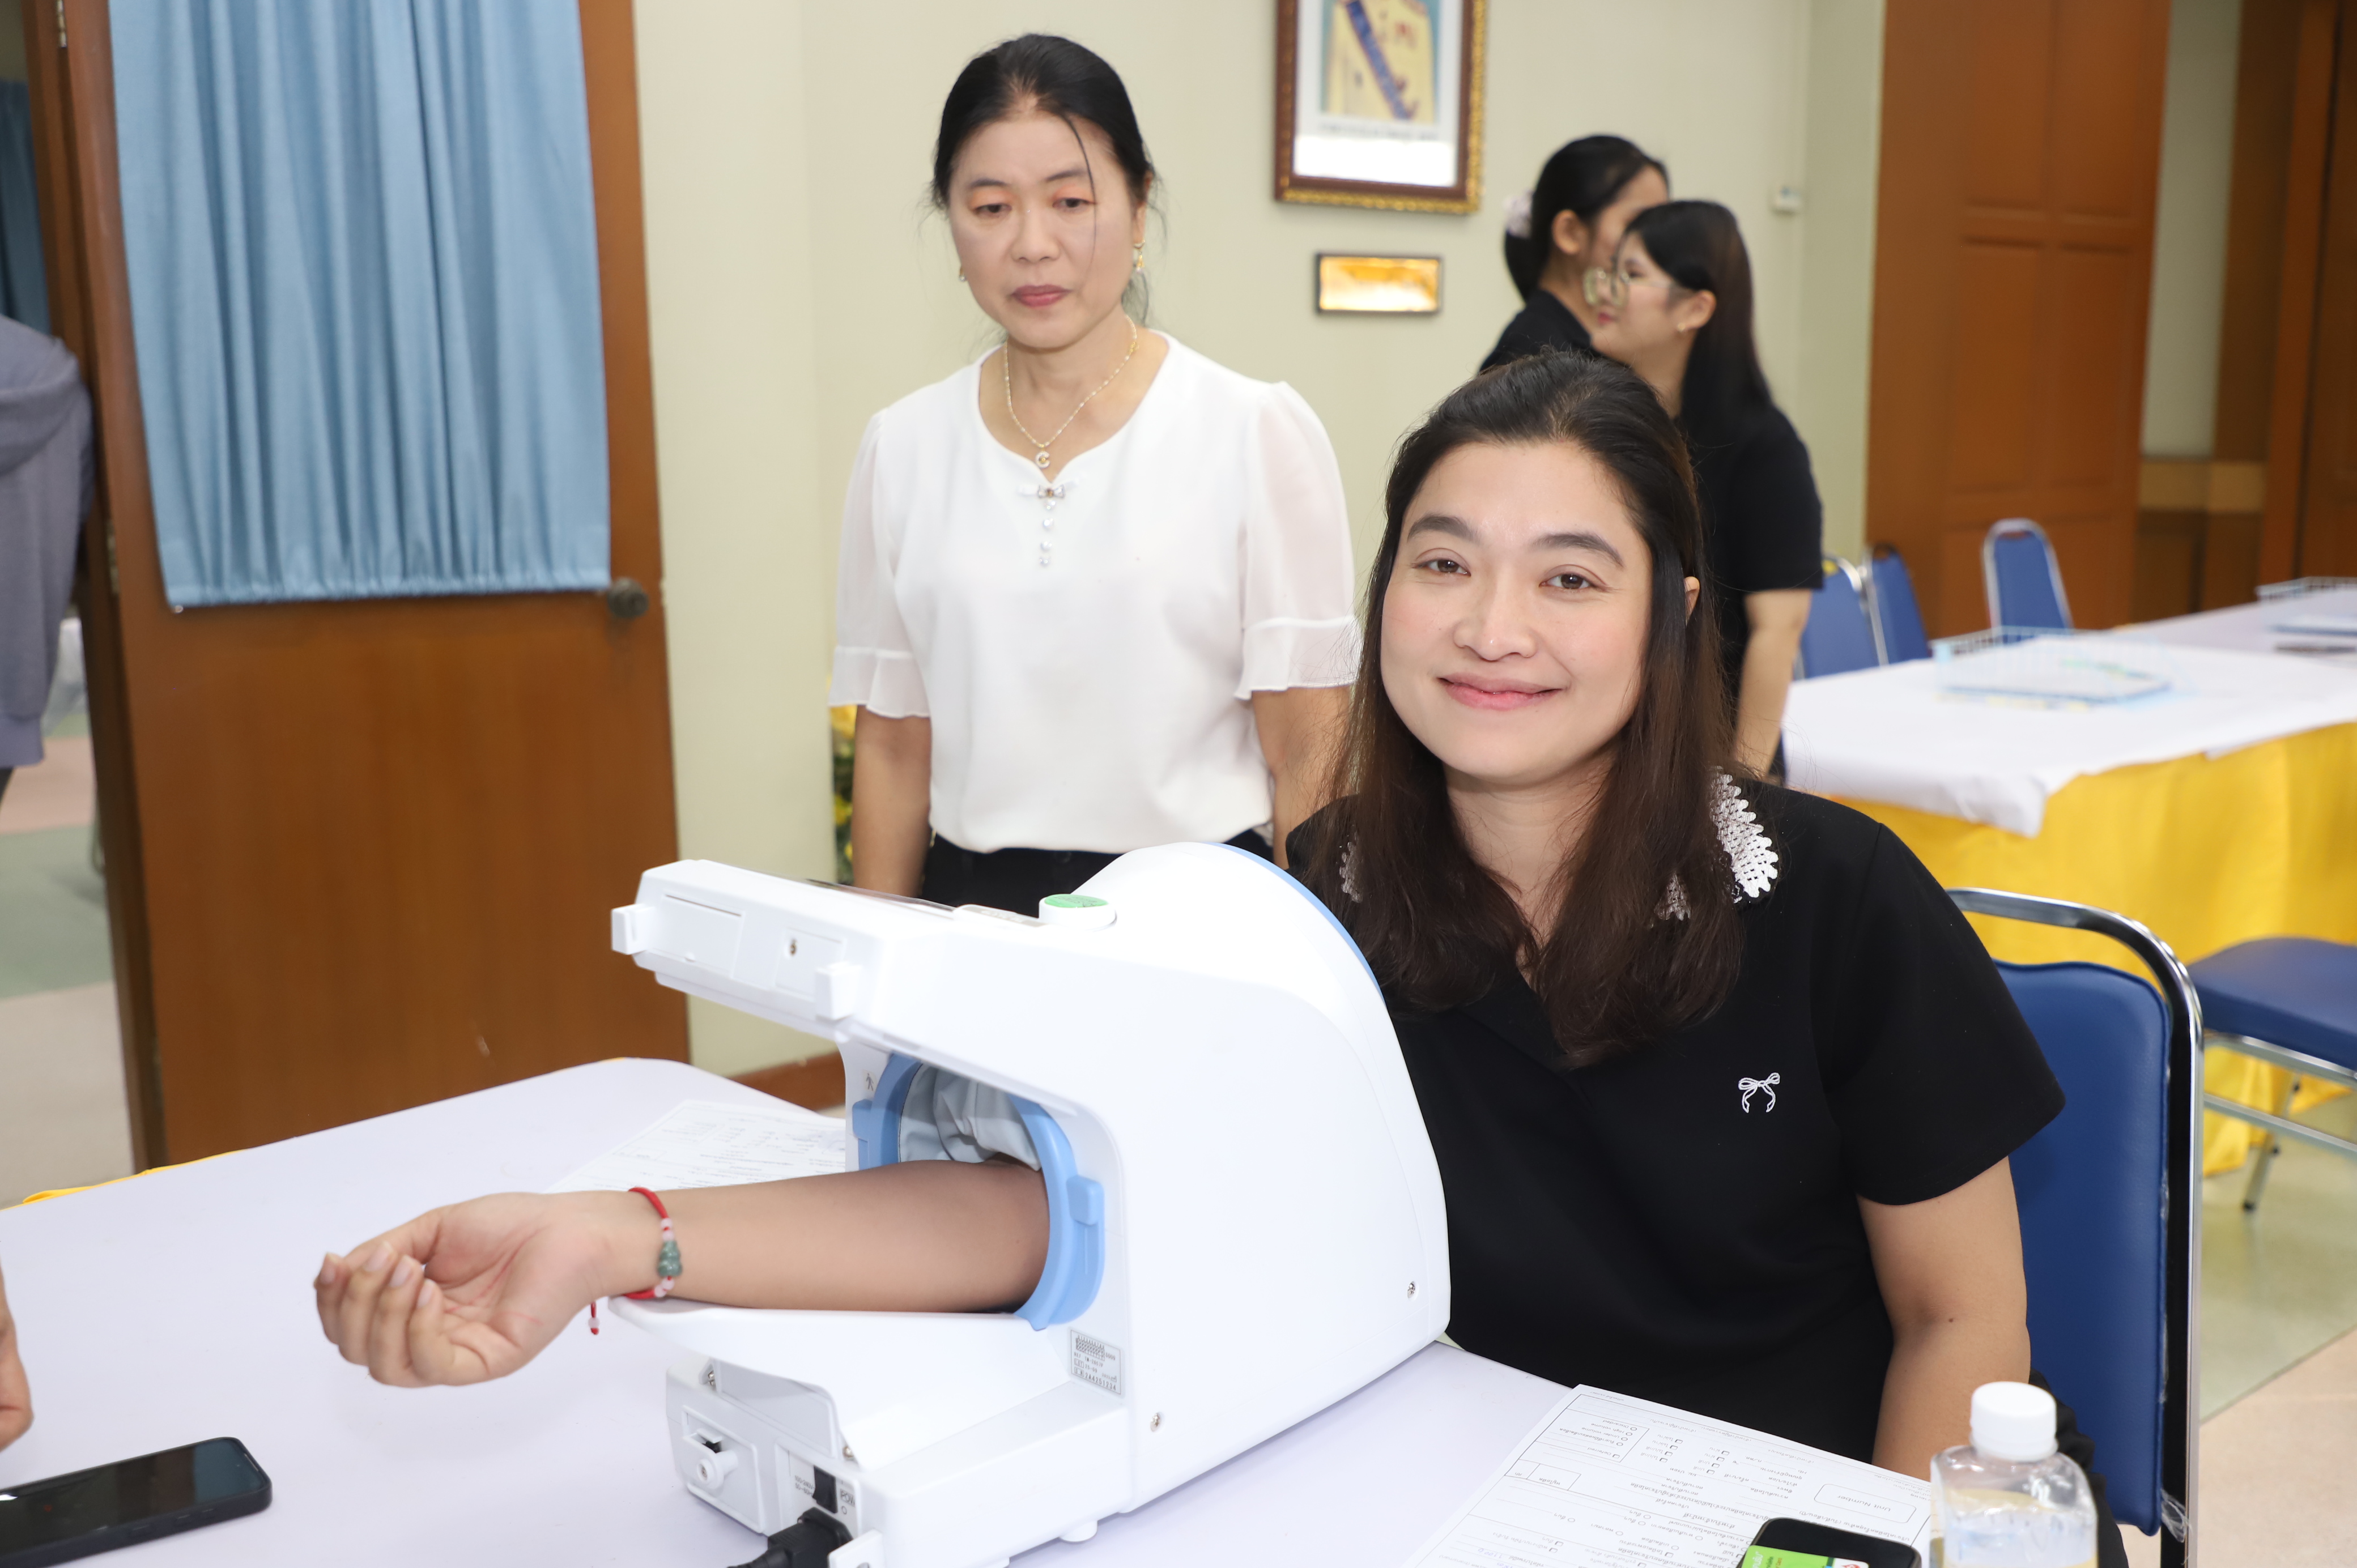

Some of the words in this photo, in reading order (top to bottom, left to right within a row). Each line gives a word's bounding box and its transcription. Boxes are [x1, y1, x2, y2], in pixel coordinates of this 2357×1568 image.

[1084, 1364, 1097, 1373] 25-09
[1085, 1372, 1116, 1391] 2A4251234
[1602, 1420, 1629, 1429] Discarded
[1587, 1447, 1611, 1456] Deferred
[841, 1490, 855, 1505] POW
[1631, 1482, 1769, 1521] ผู้บริจาคโลหิตประจำไม่มีบัตรประจำตัวผู้บริจาคโลหิต
[1838, 1495, 1871, 1506] Number
